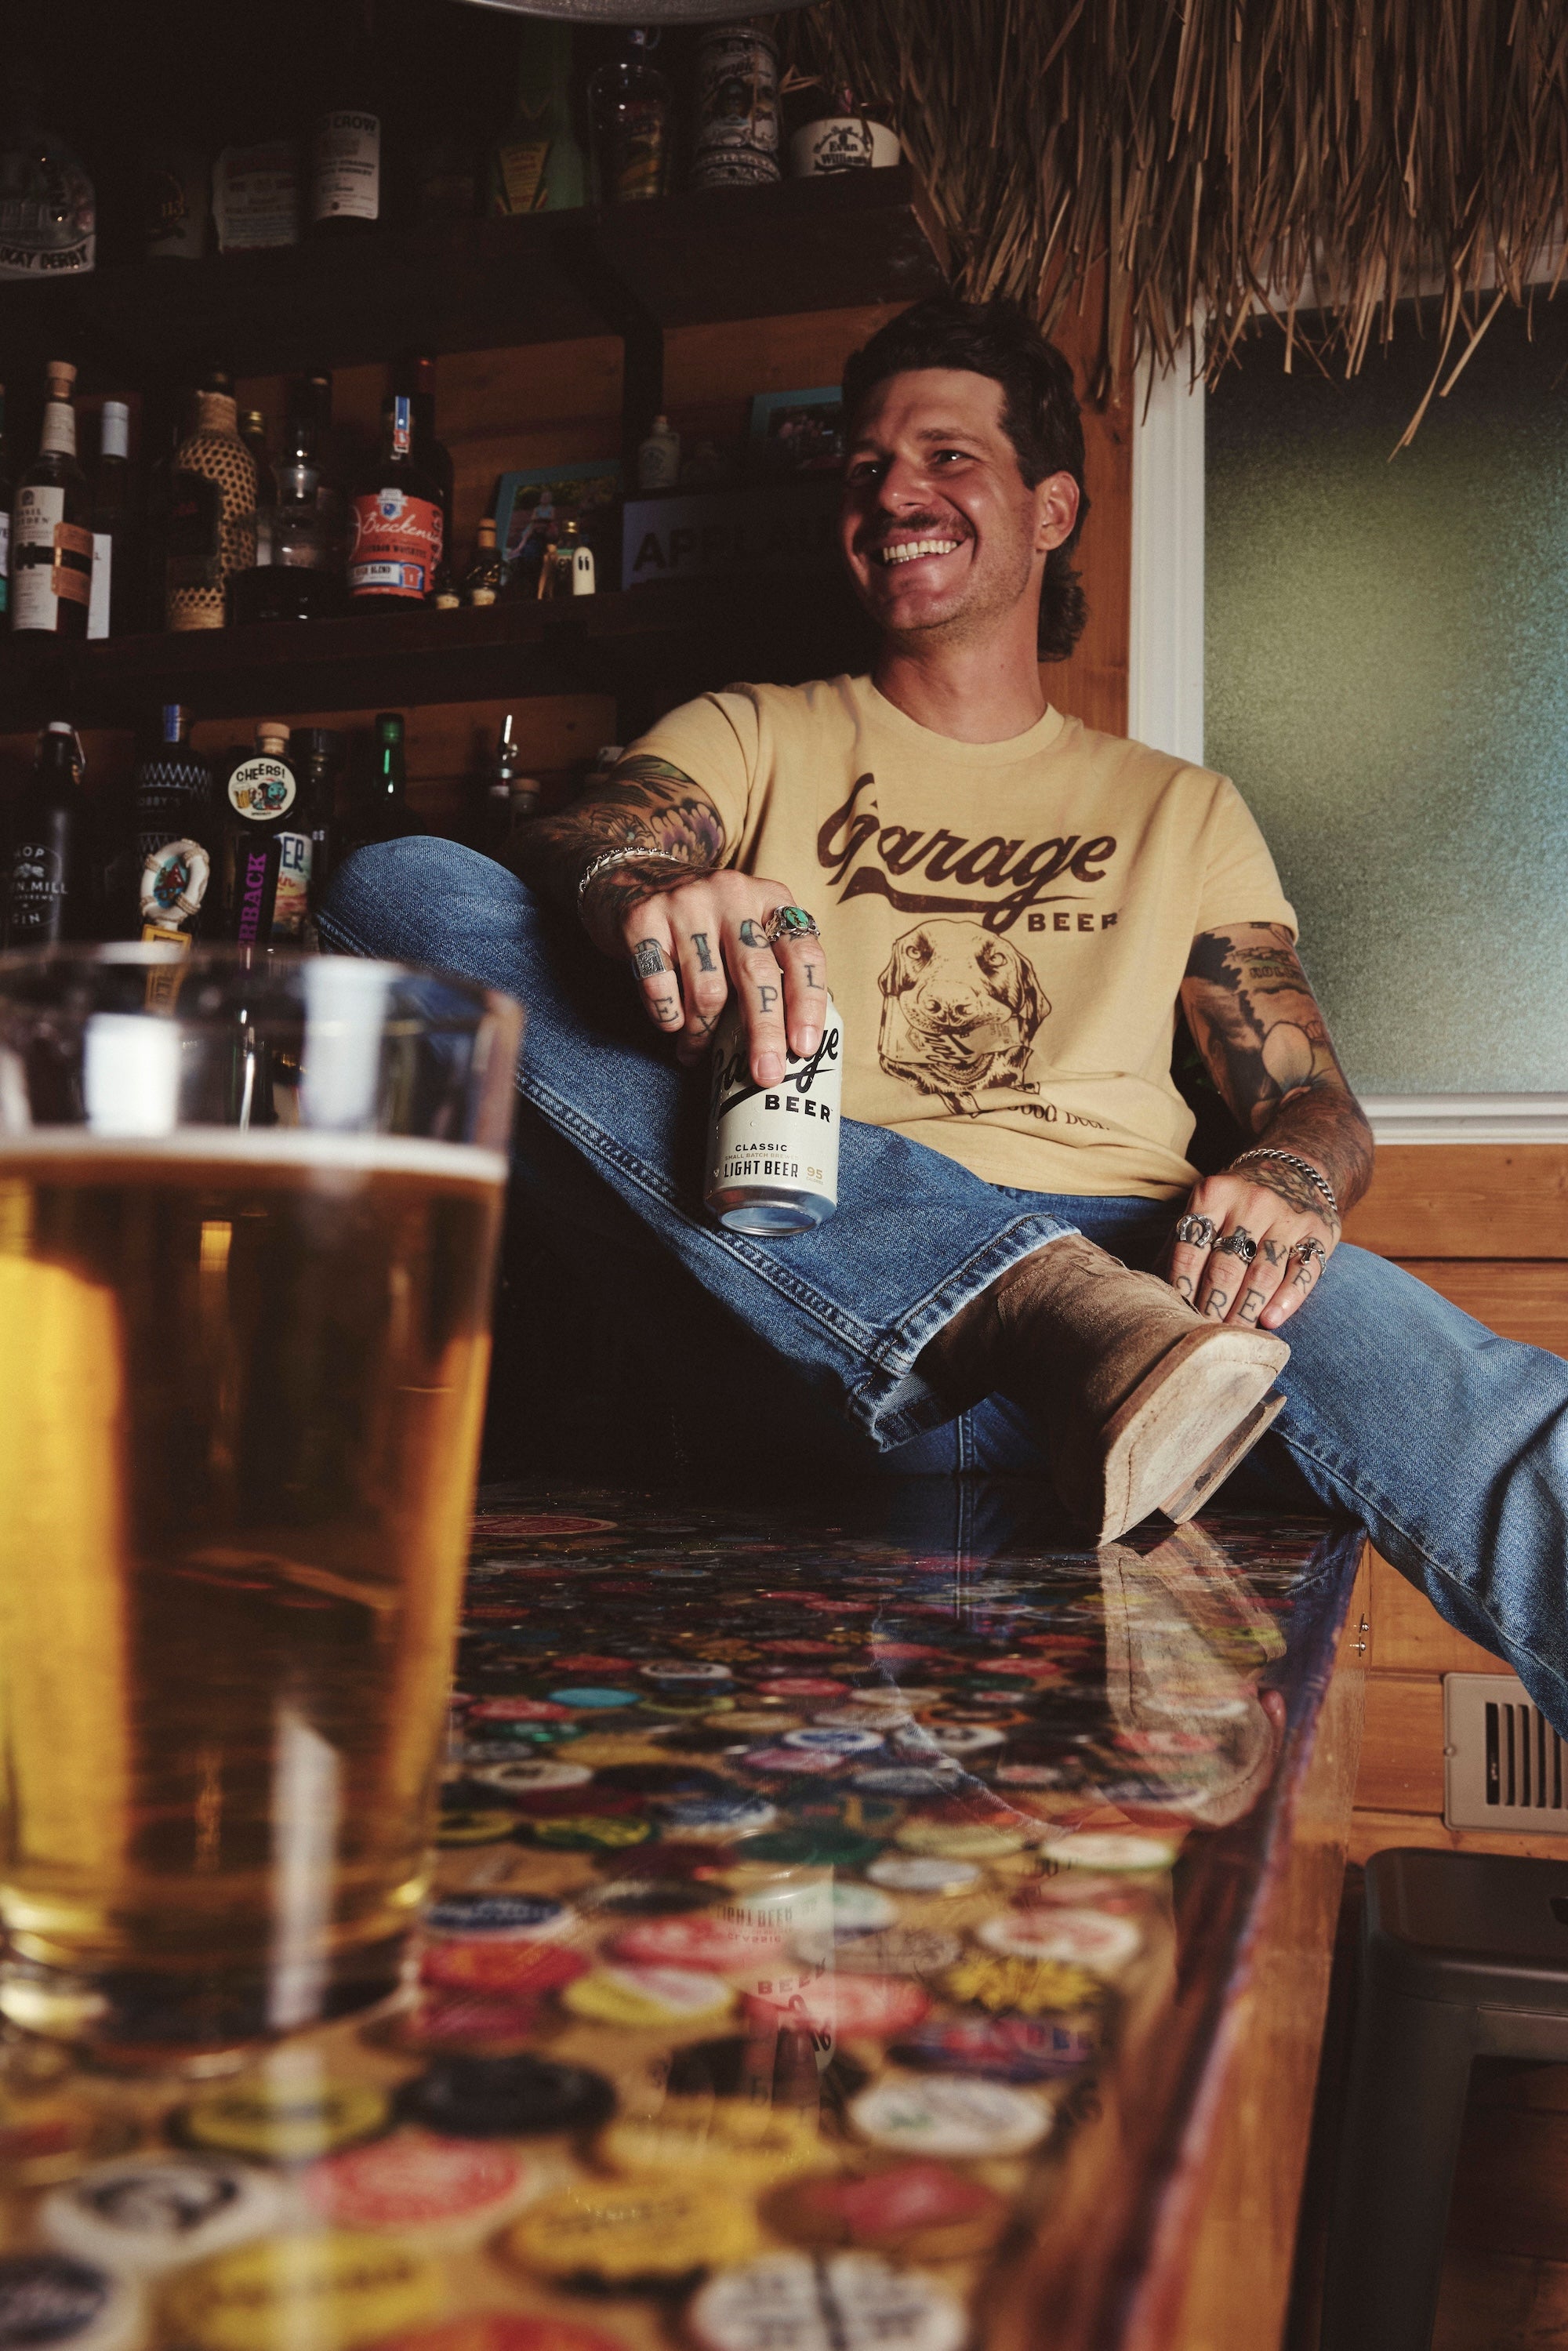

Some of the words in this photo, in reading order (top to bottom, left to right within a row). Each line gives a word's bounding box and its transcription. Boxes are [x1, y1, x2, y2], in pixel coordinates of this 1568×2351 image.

[333, 117, 376, 131] CROW
[41, 244, 87, 270] DERBY
[236, 764, 285, 782] CHEERS!
[816, 771, 1117, 934] Garage
[12, 912, 41, 925] GIN
[1028, 912, 1120, 933] BEER
[764, 1094, 830, 1123] BEER
[735, 1143, 788, 1152] CLASSIC
[724, 1160, 760, 1178] LIGHT
[764, 1160, 798, 1178] BEER
[807, 1166, 823, 1180] 95
